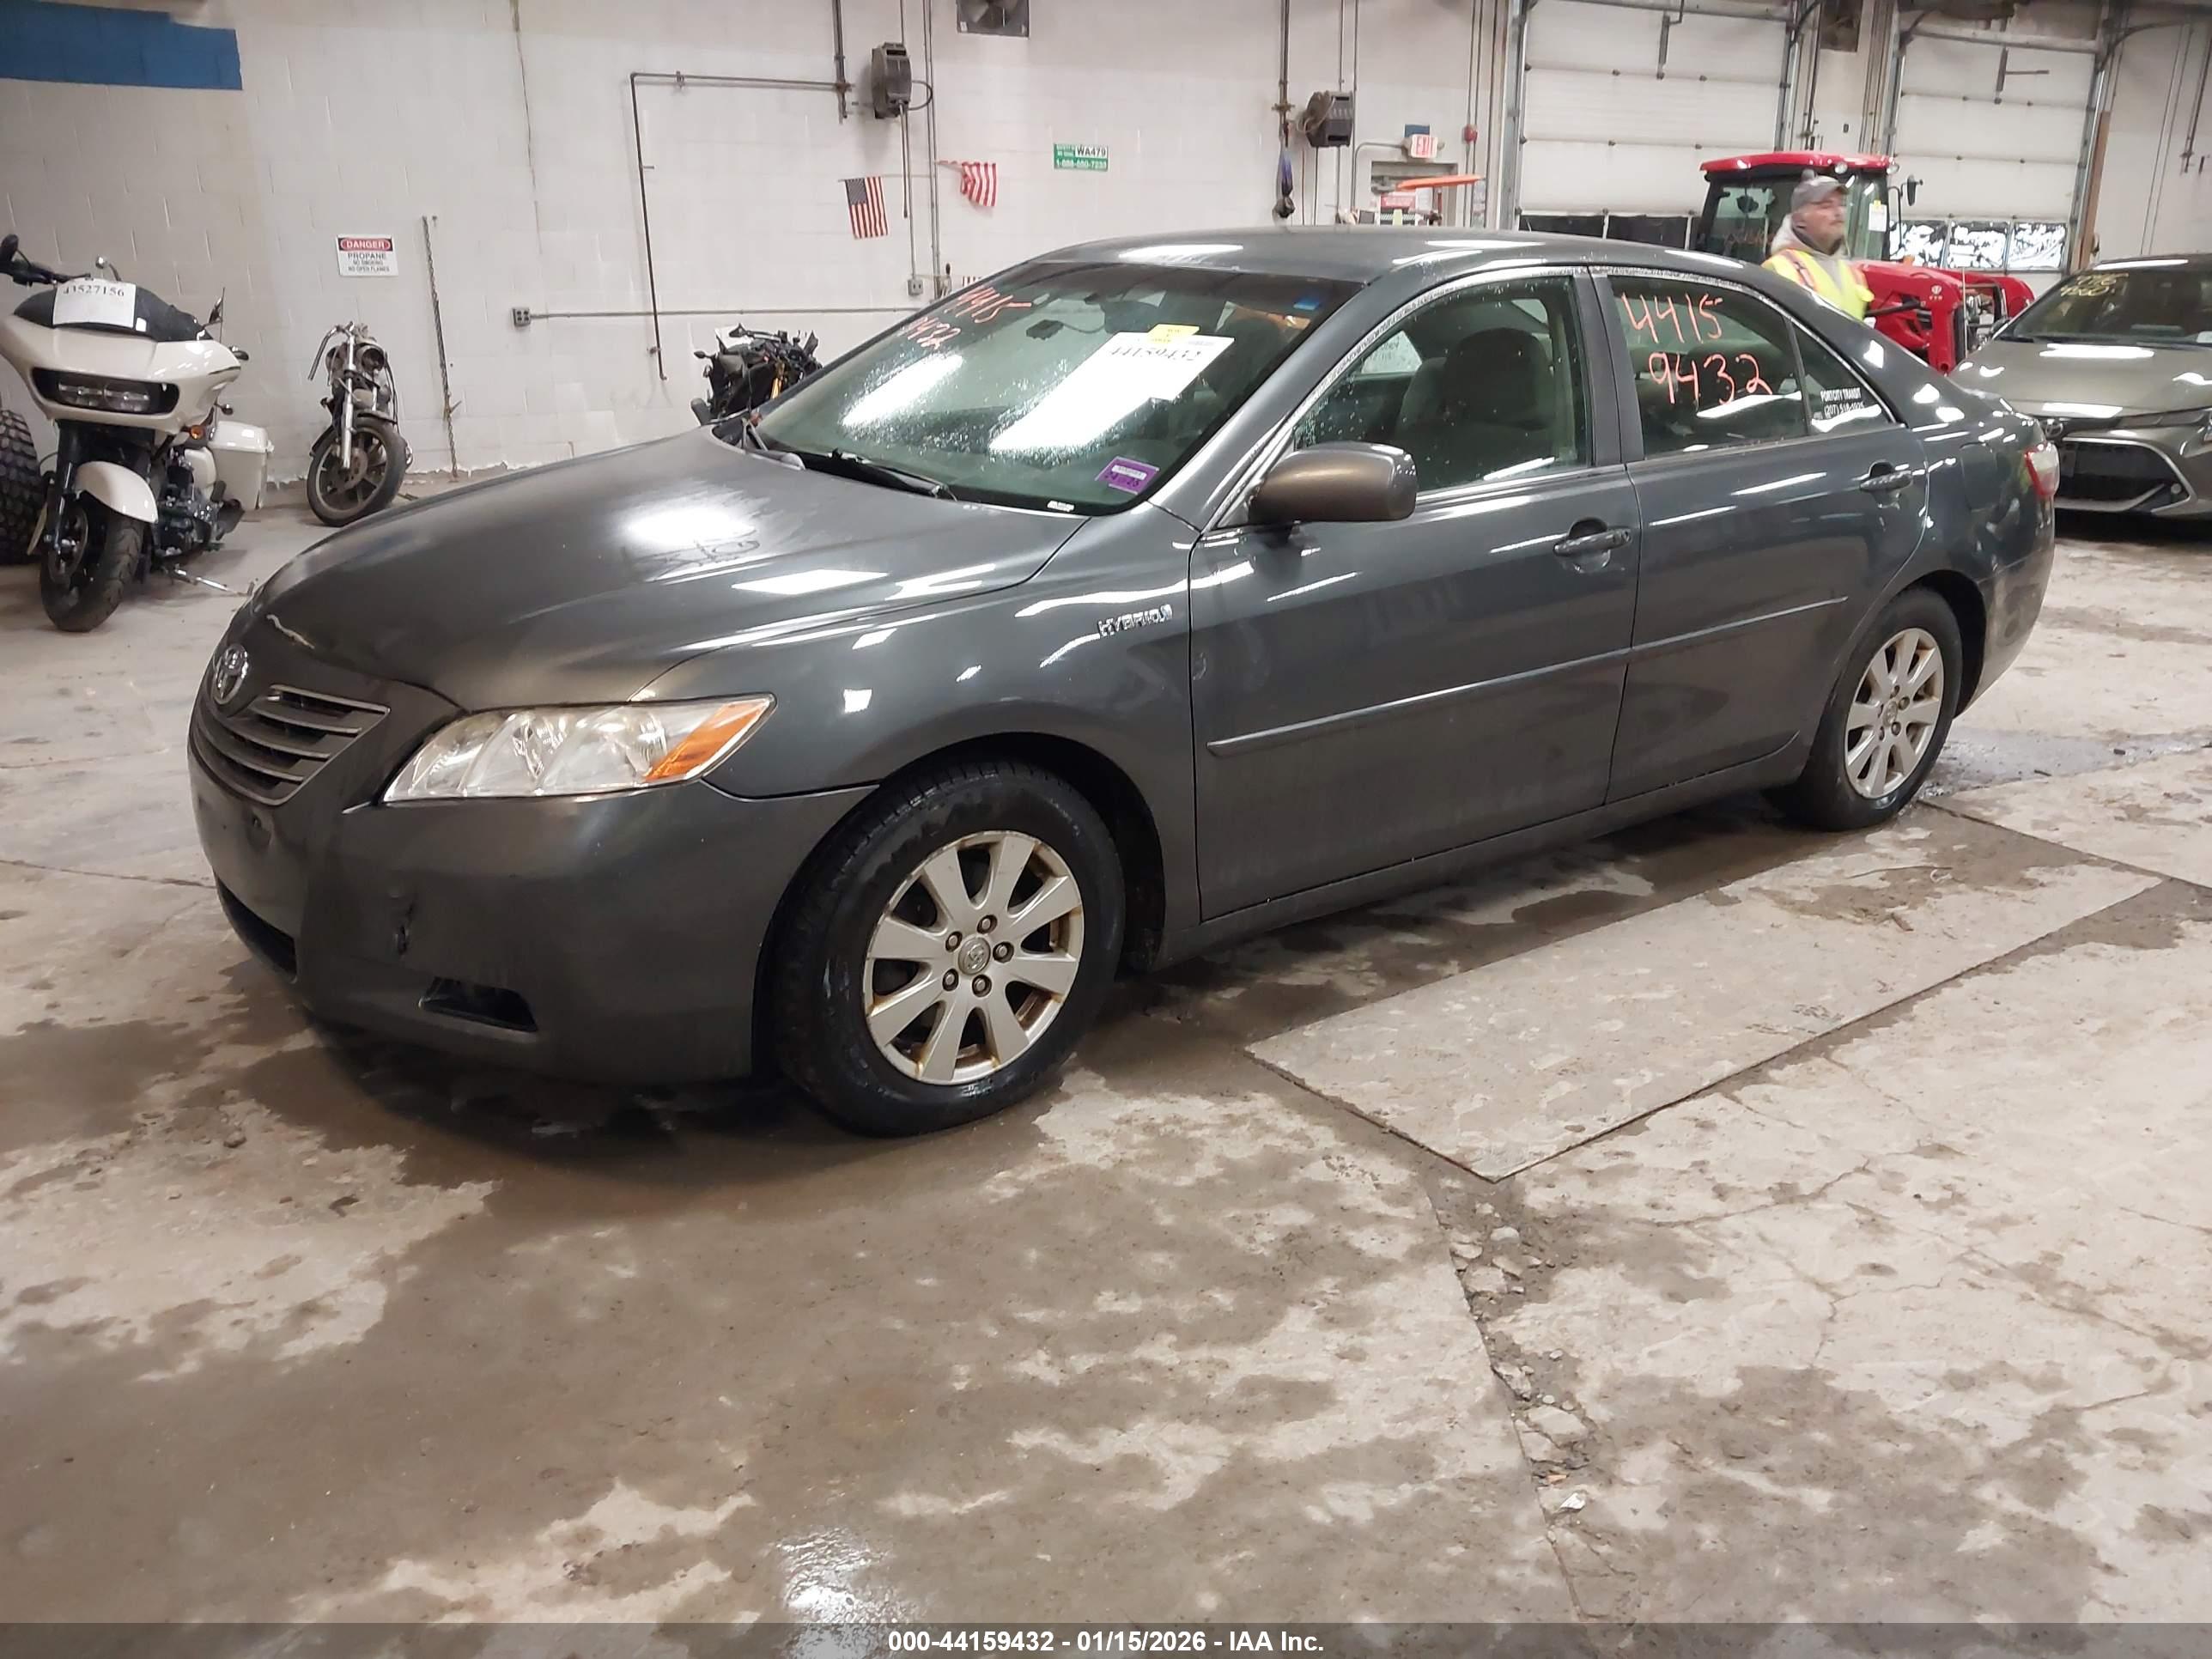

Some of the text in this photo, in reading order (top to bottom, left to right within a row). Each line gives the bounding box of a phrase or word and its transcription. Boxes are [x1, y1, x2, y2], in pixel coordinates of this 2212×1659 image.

[346, 240, 385, 248] DANGER
[1621, 292, 1723, 343] 4415
[1649, 352, 1773, 411] 9432
[1097, 609, 1159, 636] HYBRID
